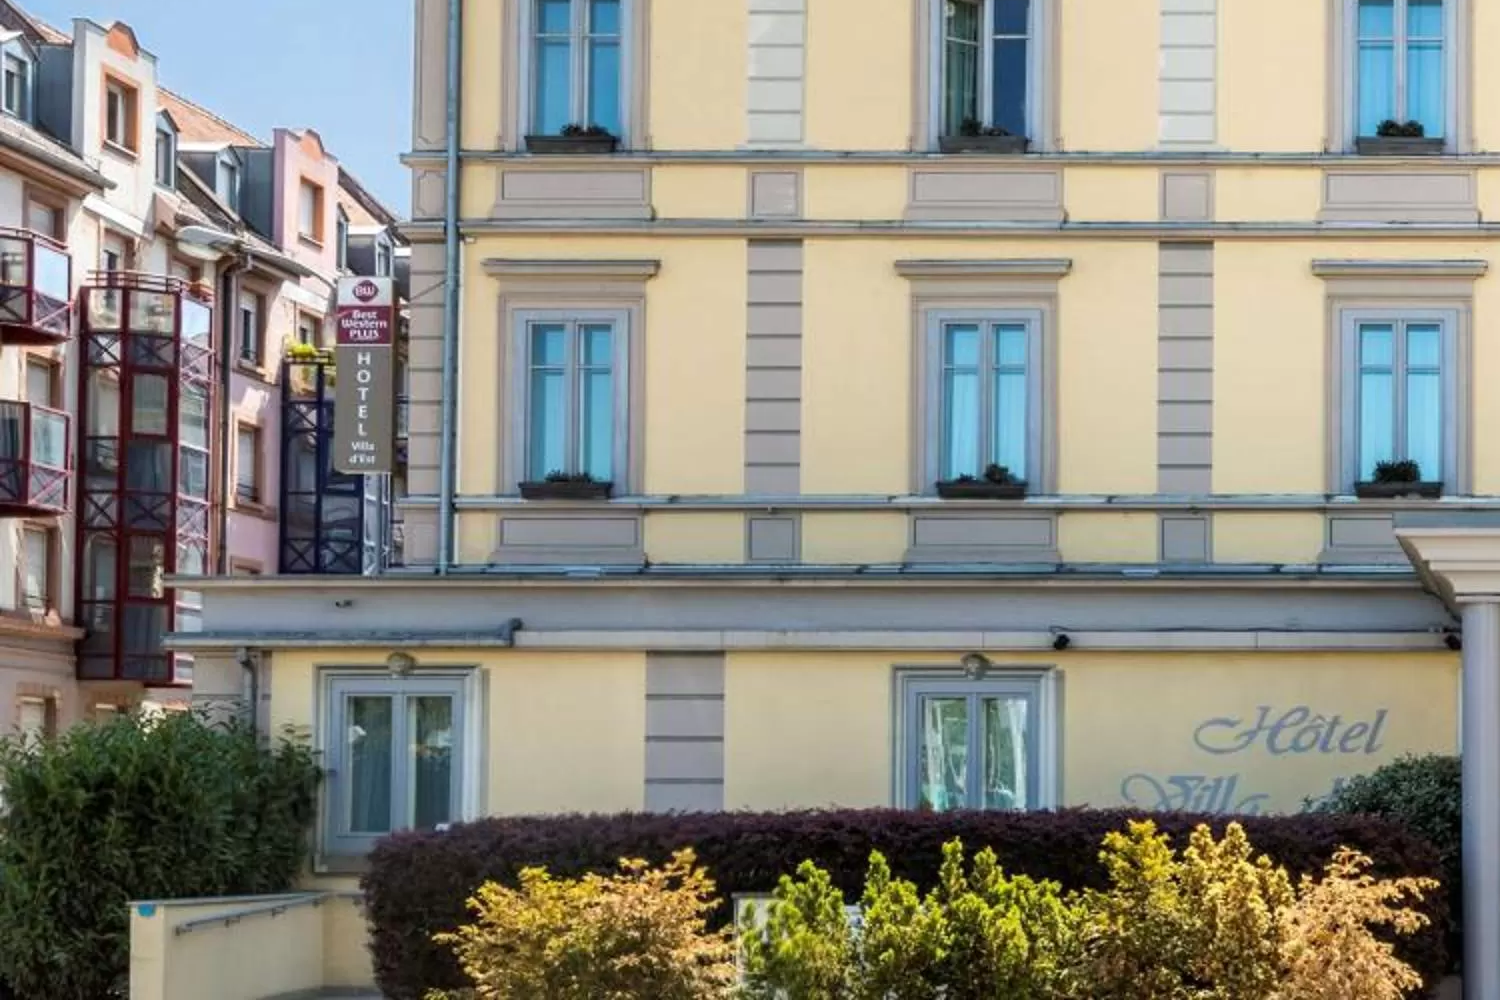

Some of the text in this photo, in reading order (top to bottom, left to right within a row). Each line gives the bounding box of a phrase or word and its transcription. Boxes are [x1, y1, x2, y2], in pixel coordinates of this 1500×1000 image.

[354, 284, 376, 297] BW
[352, 309, 377, 319] Best
[341, 319, 388, 329] Western
[350, 329, 380, 338] PLUS
[356, 351, 372, 436] HOTEL
[351, 441, 376, 451] Villa
[1193, 705, 1389, 756] Hôtel
